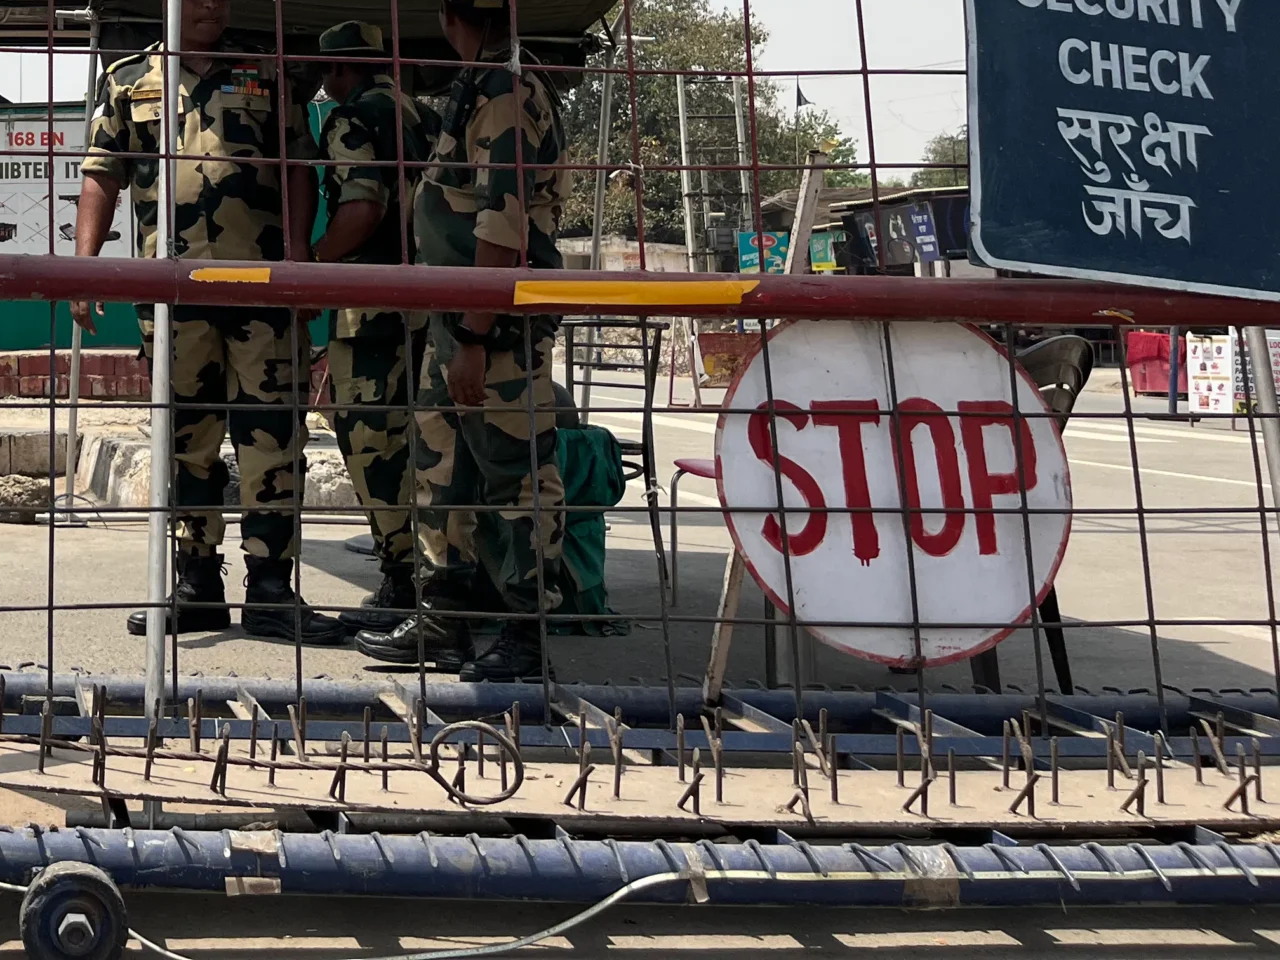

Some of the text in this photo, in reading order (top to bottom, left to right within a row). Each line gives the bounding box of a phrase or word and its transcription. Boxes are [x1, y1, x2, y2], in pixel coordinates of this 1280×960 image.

[1058, 37, 1214, 100] CHECK
[7, 131, 35, 146] 168
[1055, 106, 1214, 184] सुरक्षा
[1081, 170, 1198, 246] जाँच
[748, 397, 1039, 567] STOP
